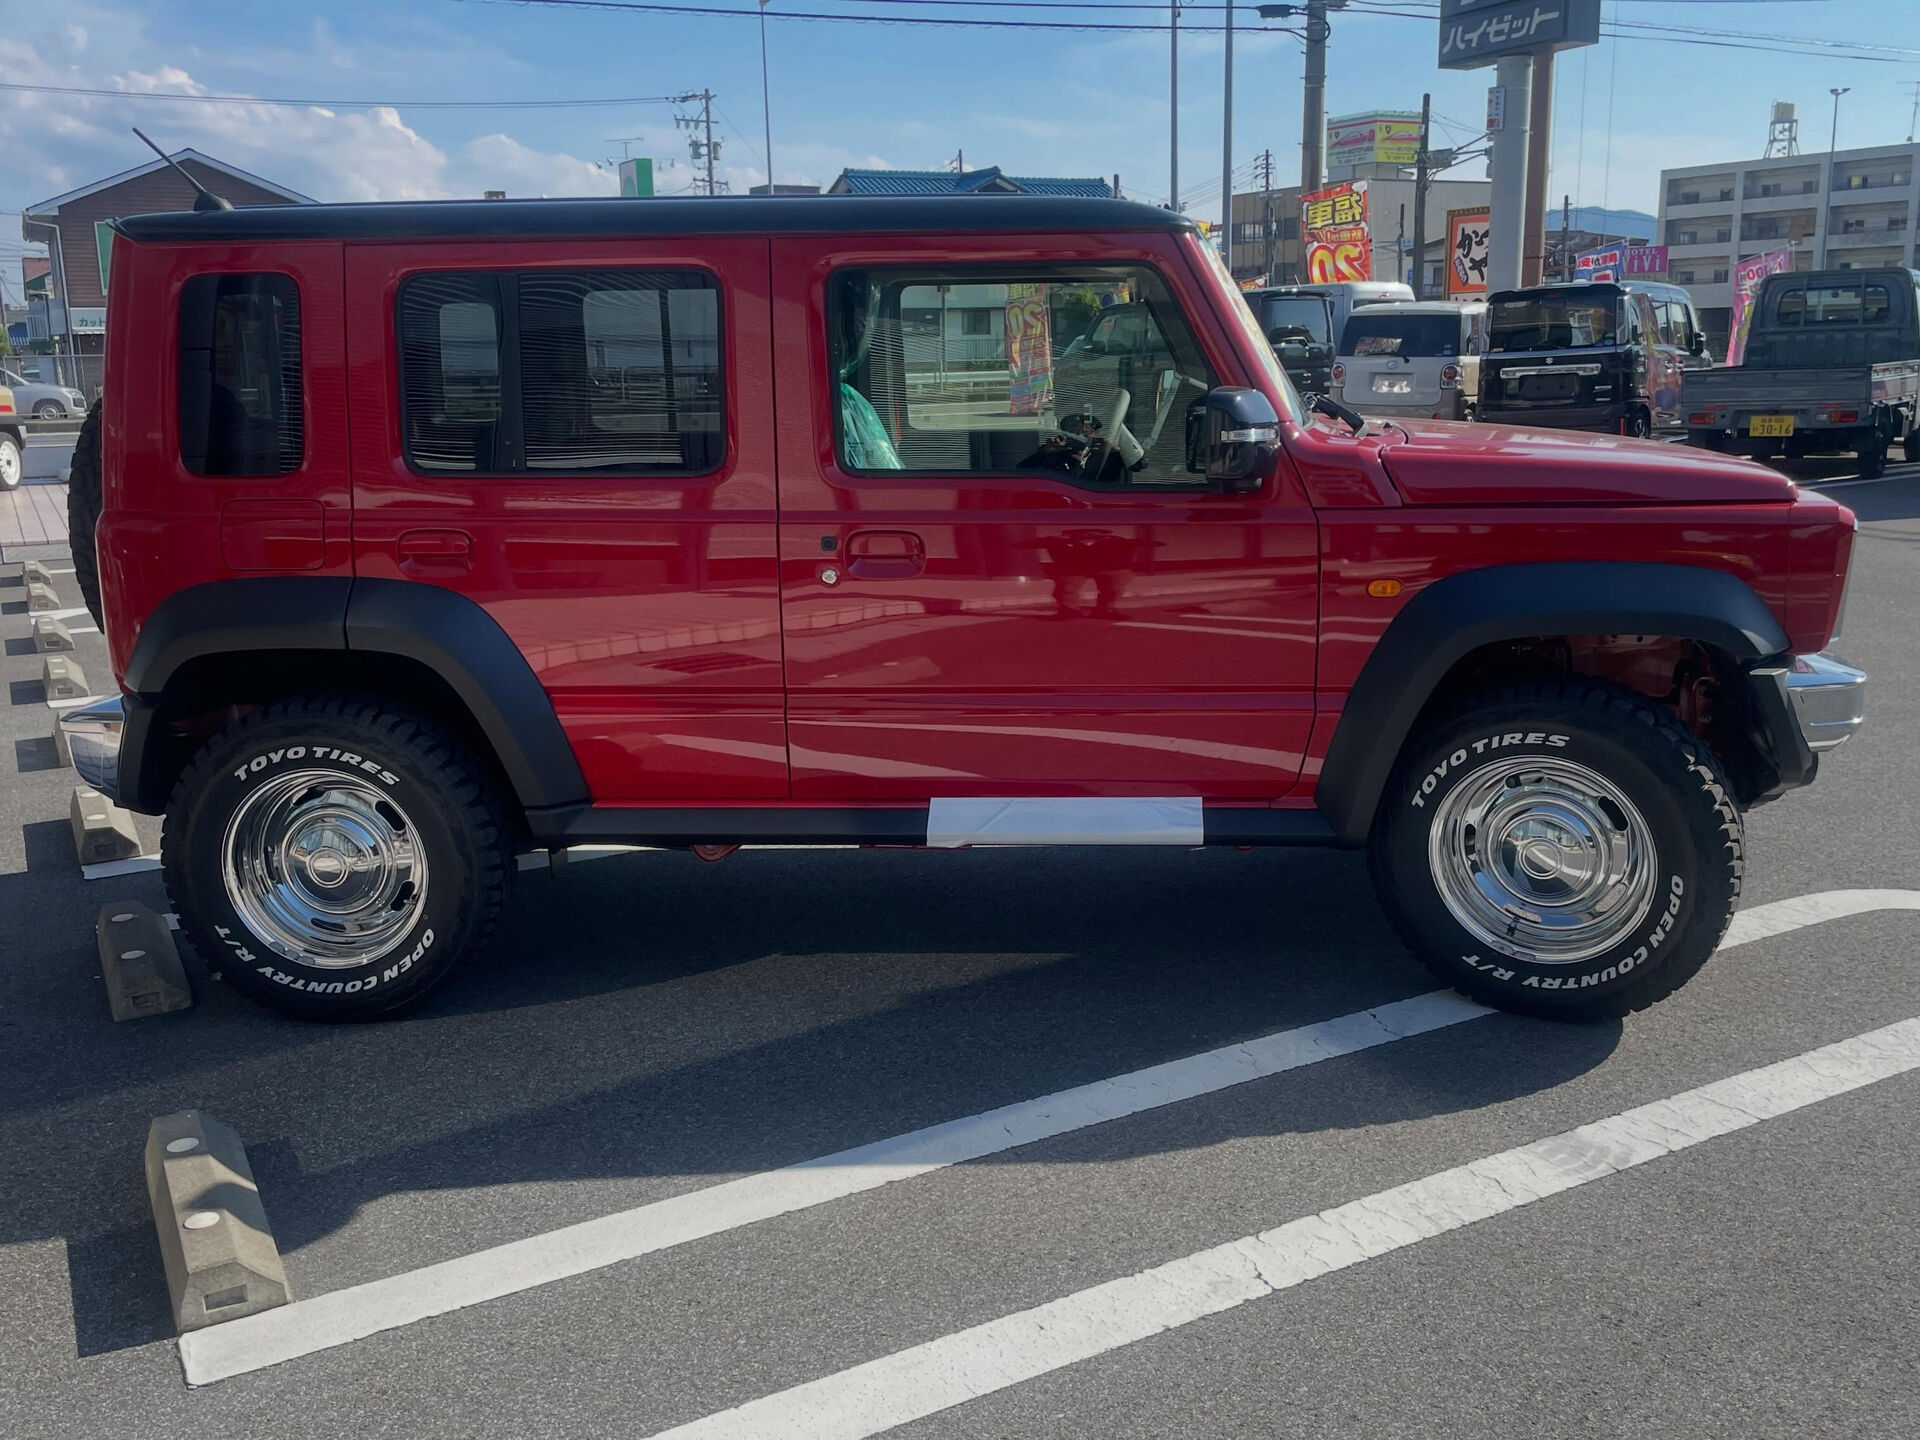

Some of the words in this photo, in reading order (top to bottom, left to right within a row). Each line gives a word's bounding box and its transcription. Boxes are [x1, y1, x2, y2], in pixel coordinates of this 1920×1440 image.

[1442, 8, 1560, 54] ハイゼット
[1624, 247, 1658, 255] HOTEL
[234, 746, 306, 781] TOYO
[311, 746, 401, 786] TIRES
[1411, 749, 1468, 809] TOYO
[1472, 732, 1571, 755] TIRES
[1649, 874, 1685, 949] OPEN
[214, 925, 257, 962] R/T
[383, 928, 435, 983] OPEN
[256, 965, 379, 994] COUNTRY
[1462, 952, 1516, 981] R/T
[1521, 945, 1649, 990] COUNTRY
